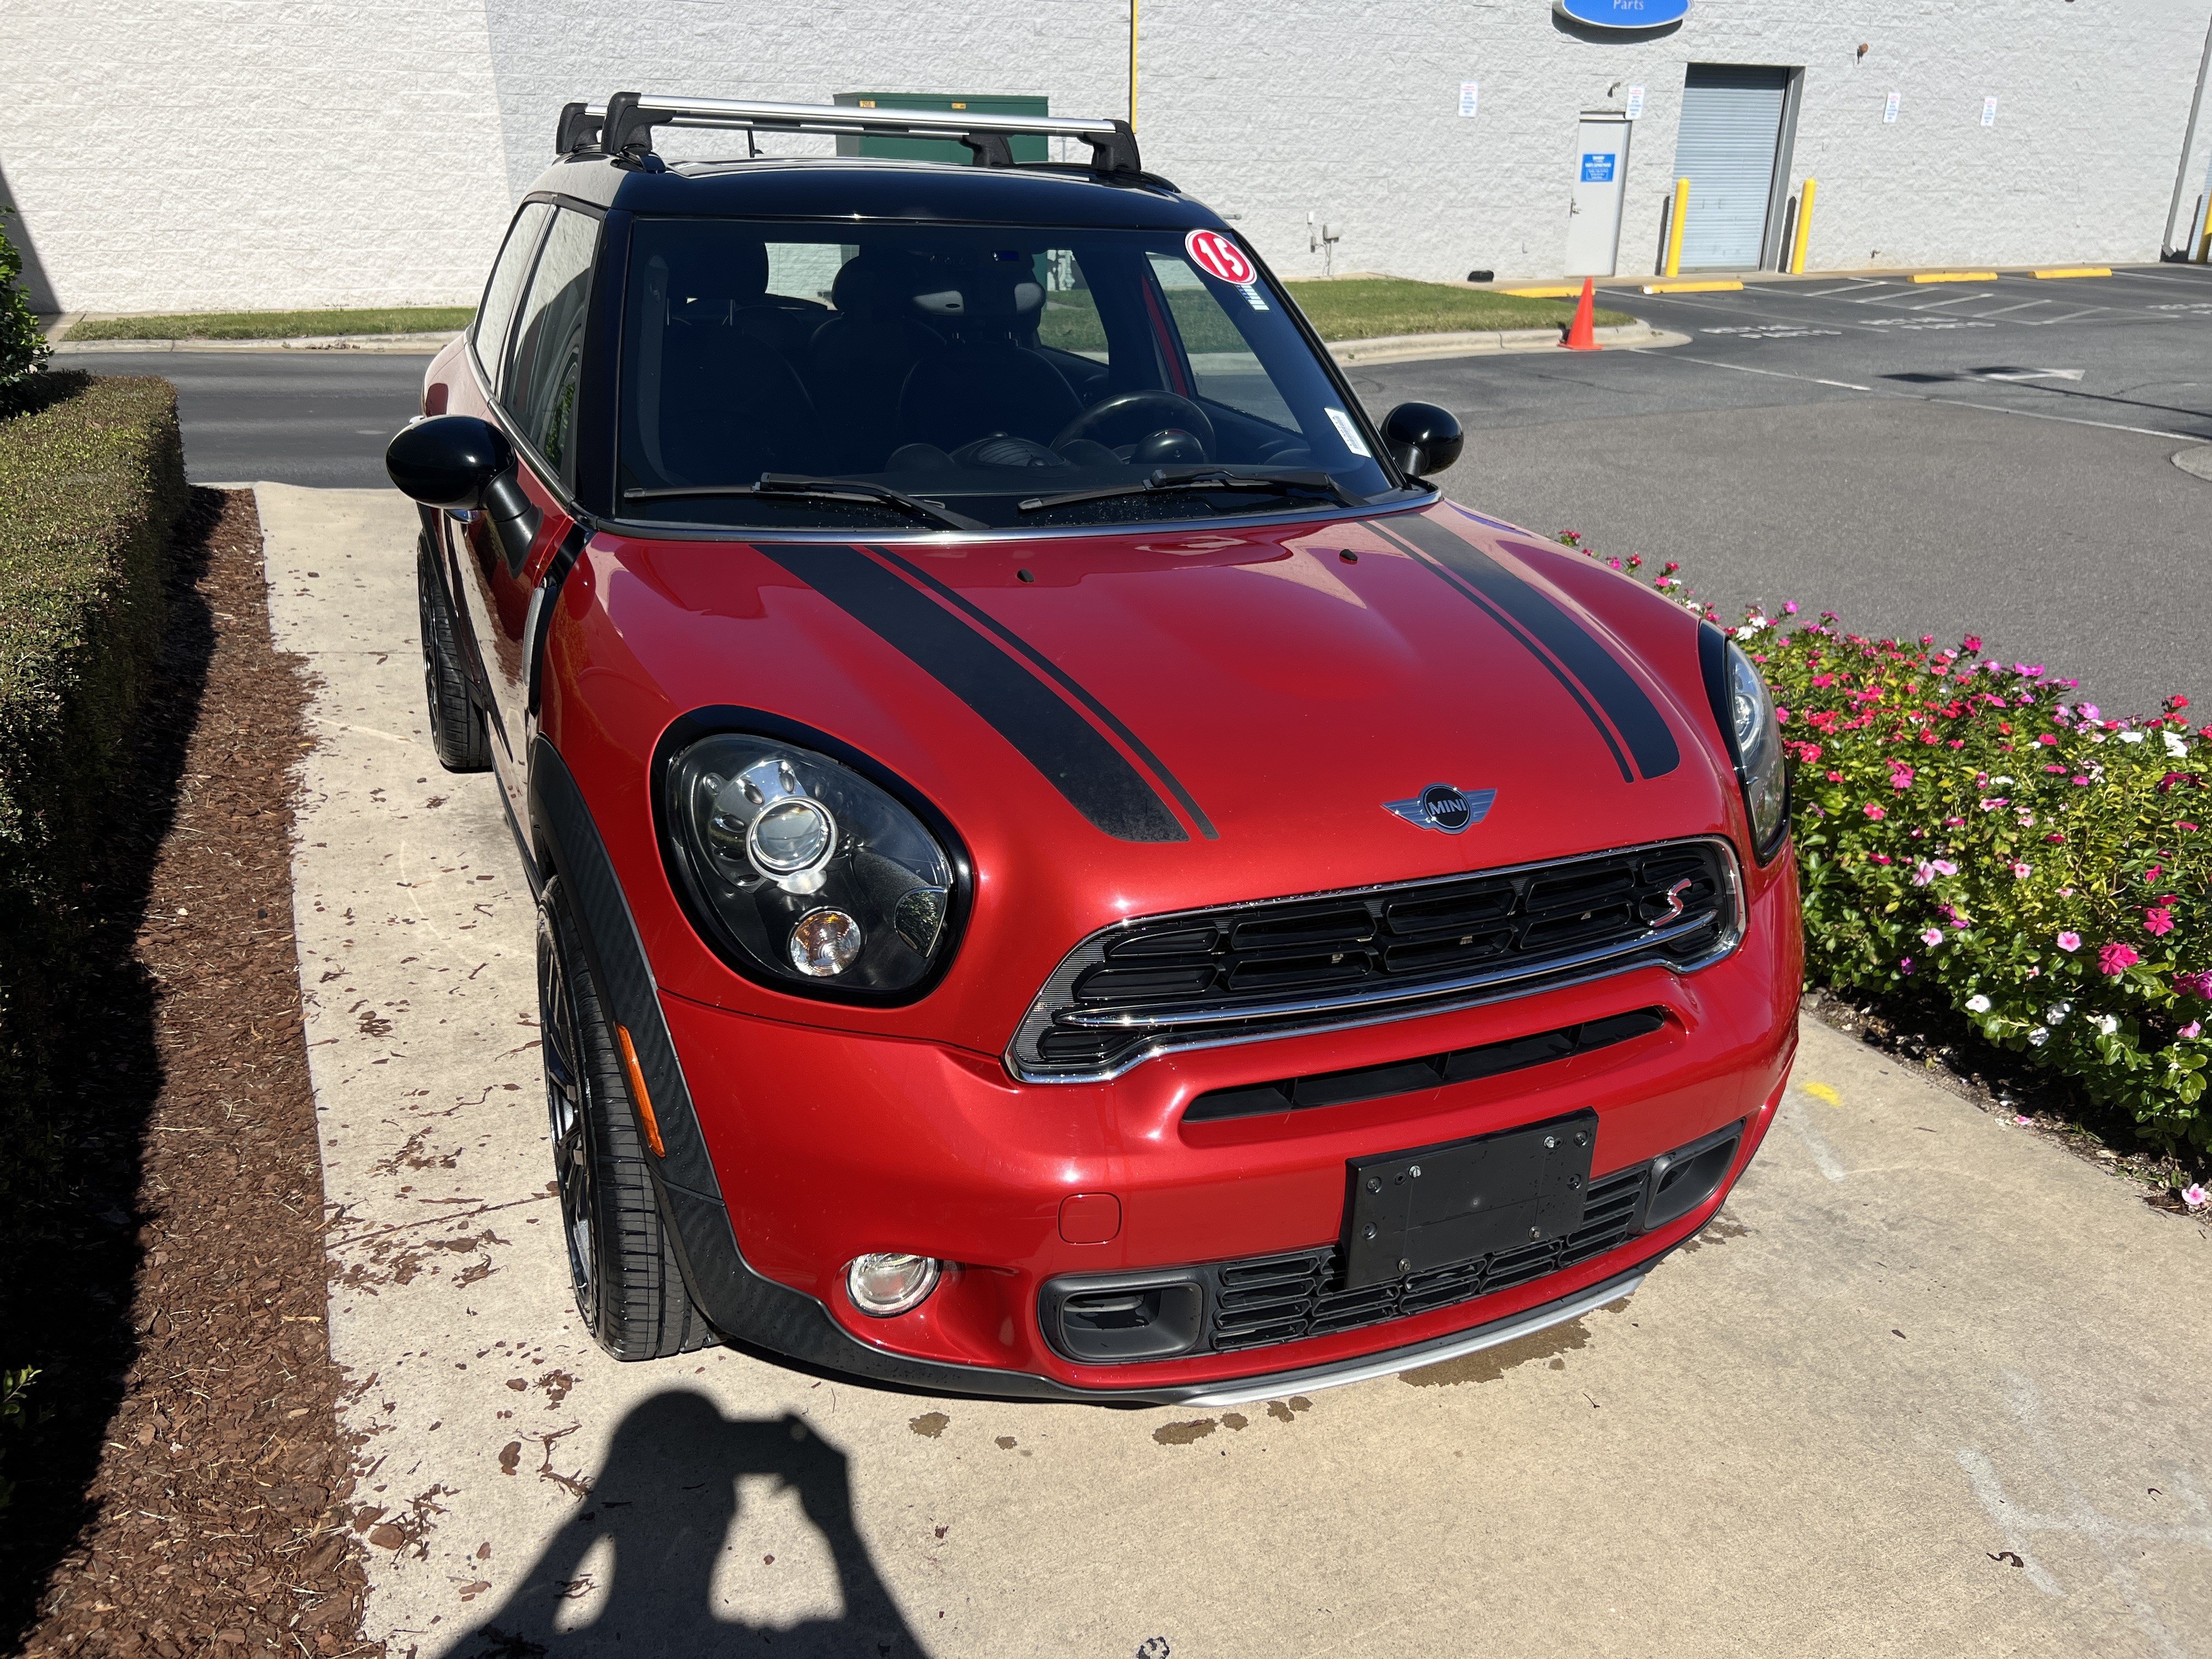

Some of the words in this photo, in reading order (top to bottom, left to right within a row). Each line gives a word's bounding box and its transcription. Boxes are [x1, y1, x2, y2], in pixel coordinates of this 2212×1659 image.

[1613, 0, 1645, 10] Parts
[1197, 238, 1244, 278] 15
[1428, 799, 1466, 815] MINI
